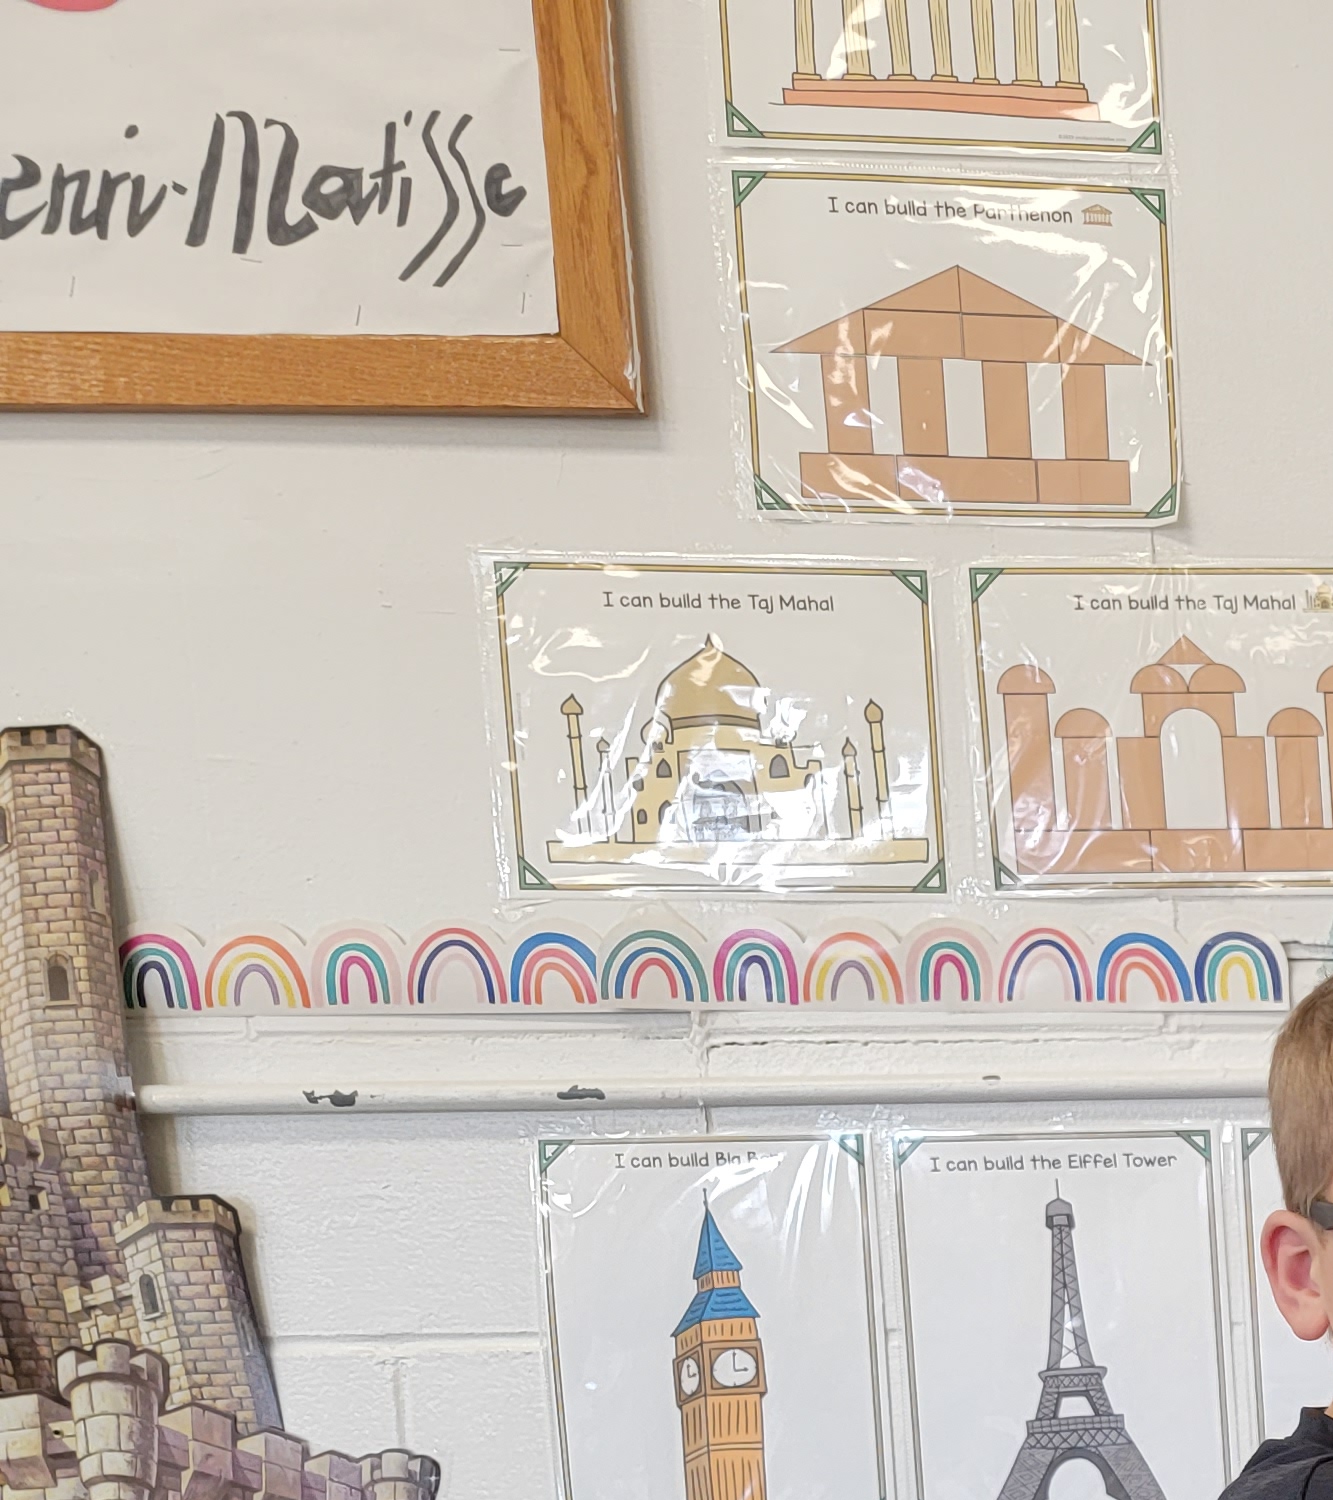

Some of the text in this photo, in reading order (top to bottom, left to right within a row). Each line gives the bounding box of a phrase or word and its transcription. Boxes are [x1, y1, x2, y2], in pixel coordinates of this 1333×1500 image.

[828, 197, 1073, 223] I can build the Parthenon
[603, 591, 834, 614] I can build the Taj Mahal
[1074, 594, 1296, 614] I can build the Taj Mahal
[615, 1153, 625, 1168] I
[631, 1156, 662, 1168] can
[668, 1152, 709, 1167] build
[930, 1152, 1177, 1172] I can build the Eiffel Tower
